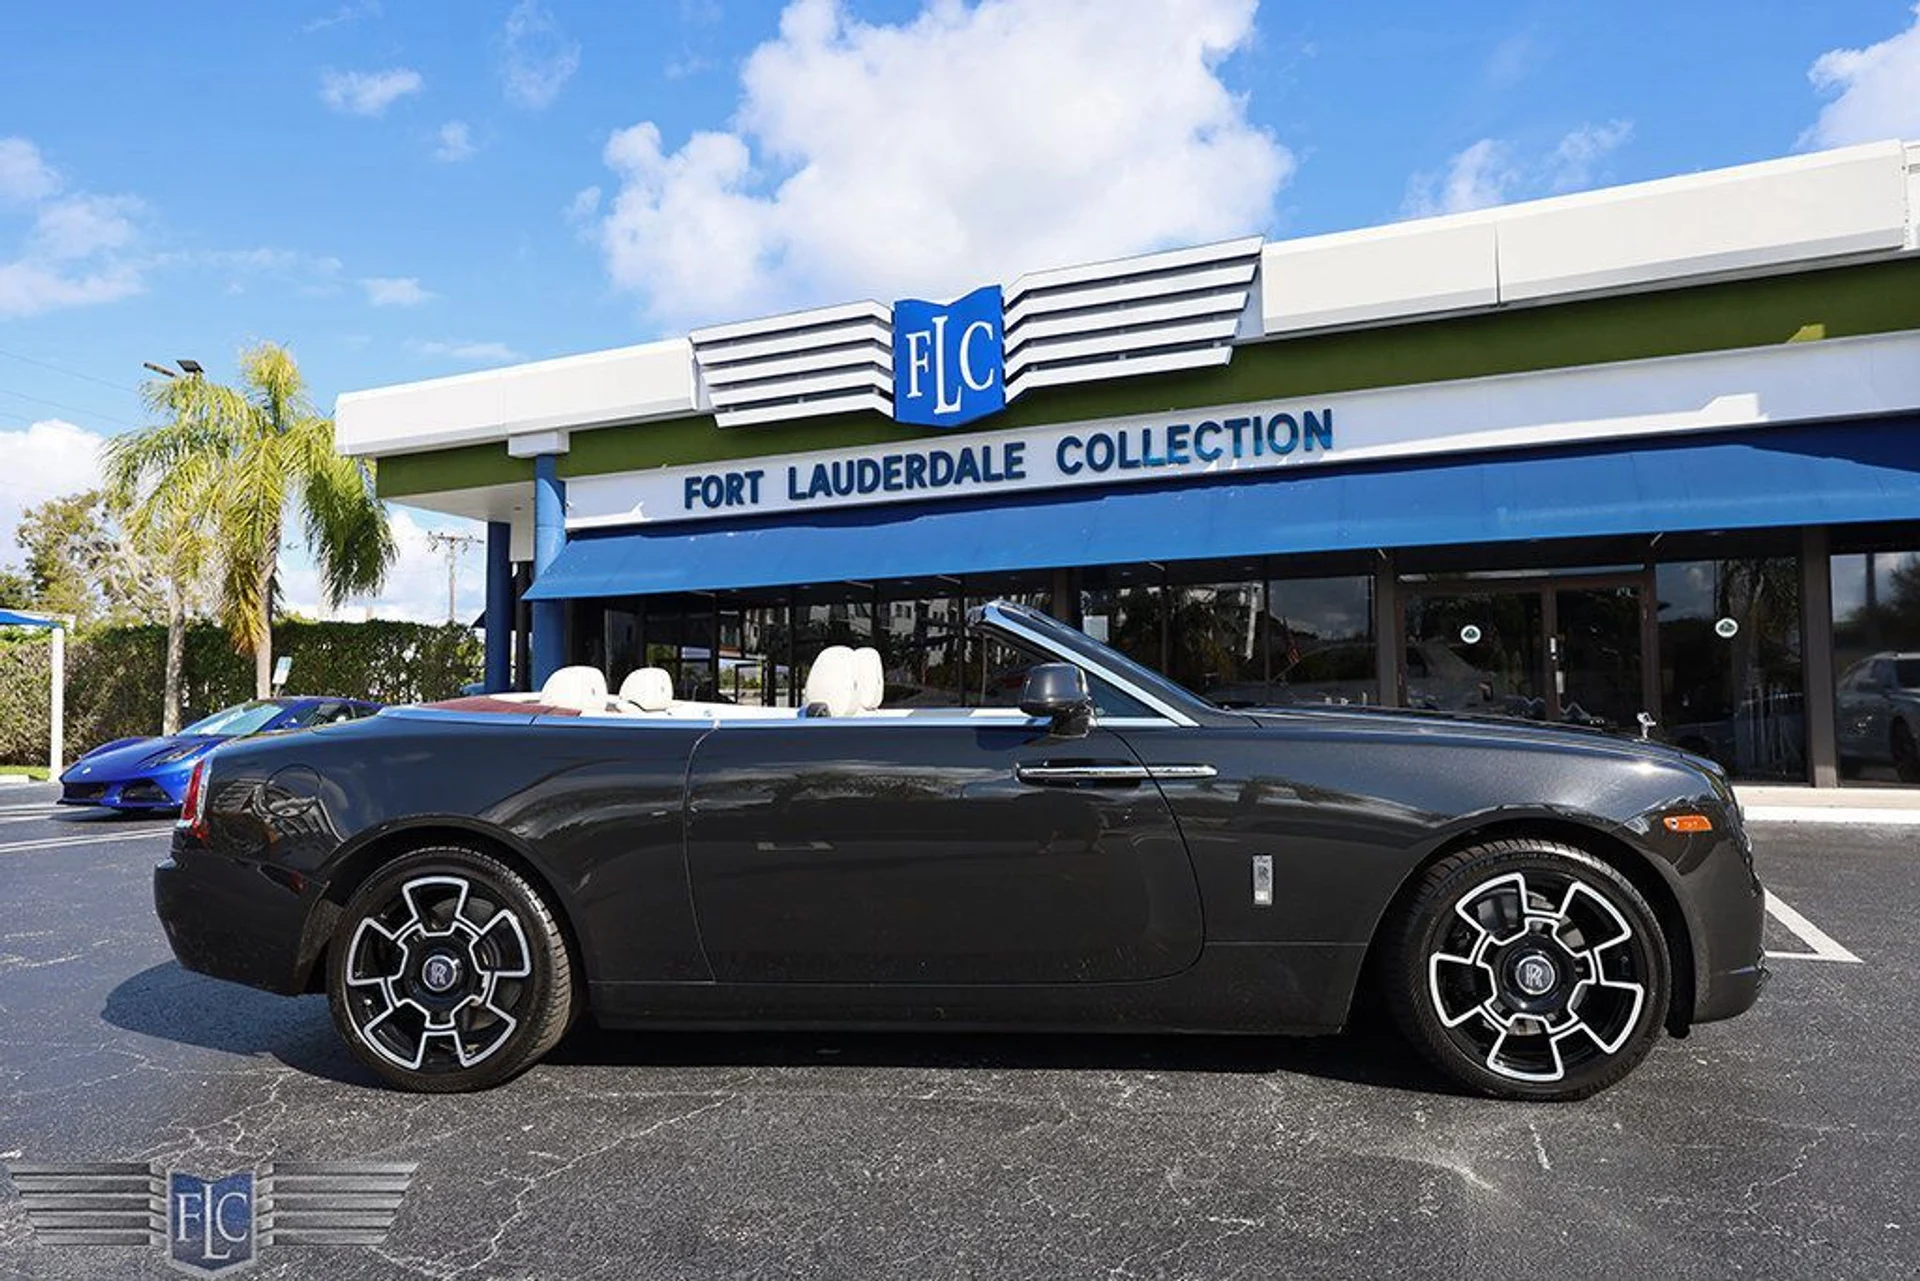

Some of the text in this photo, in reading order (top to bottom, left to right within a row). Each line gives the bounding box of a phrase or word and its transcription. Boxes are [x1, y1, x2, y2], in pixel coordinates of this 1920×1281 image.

[906, 316, 994, 414] FLC
[685, 408, 1333, 509] FORT LAUDERDALE COLLECTION
